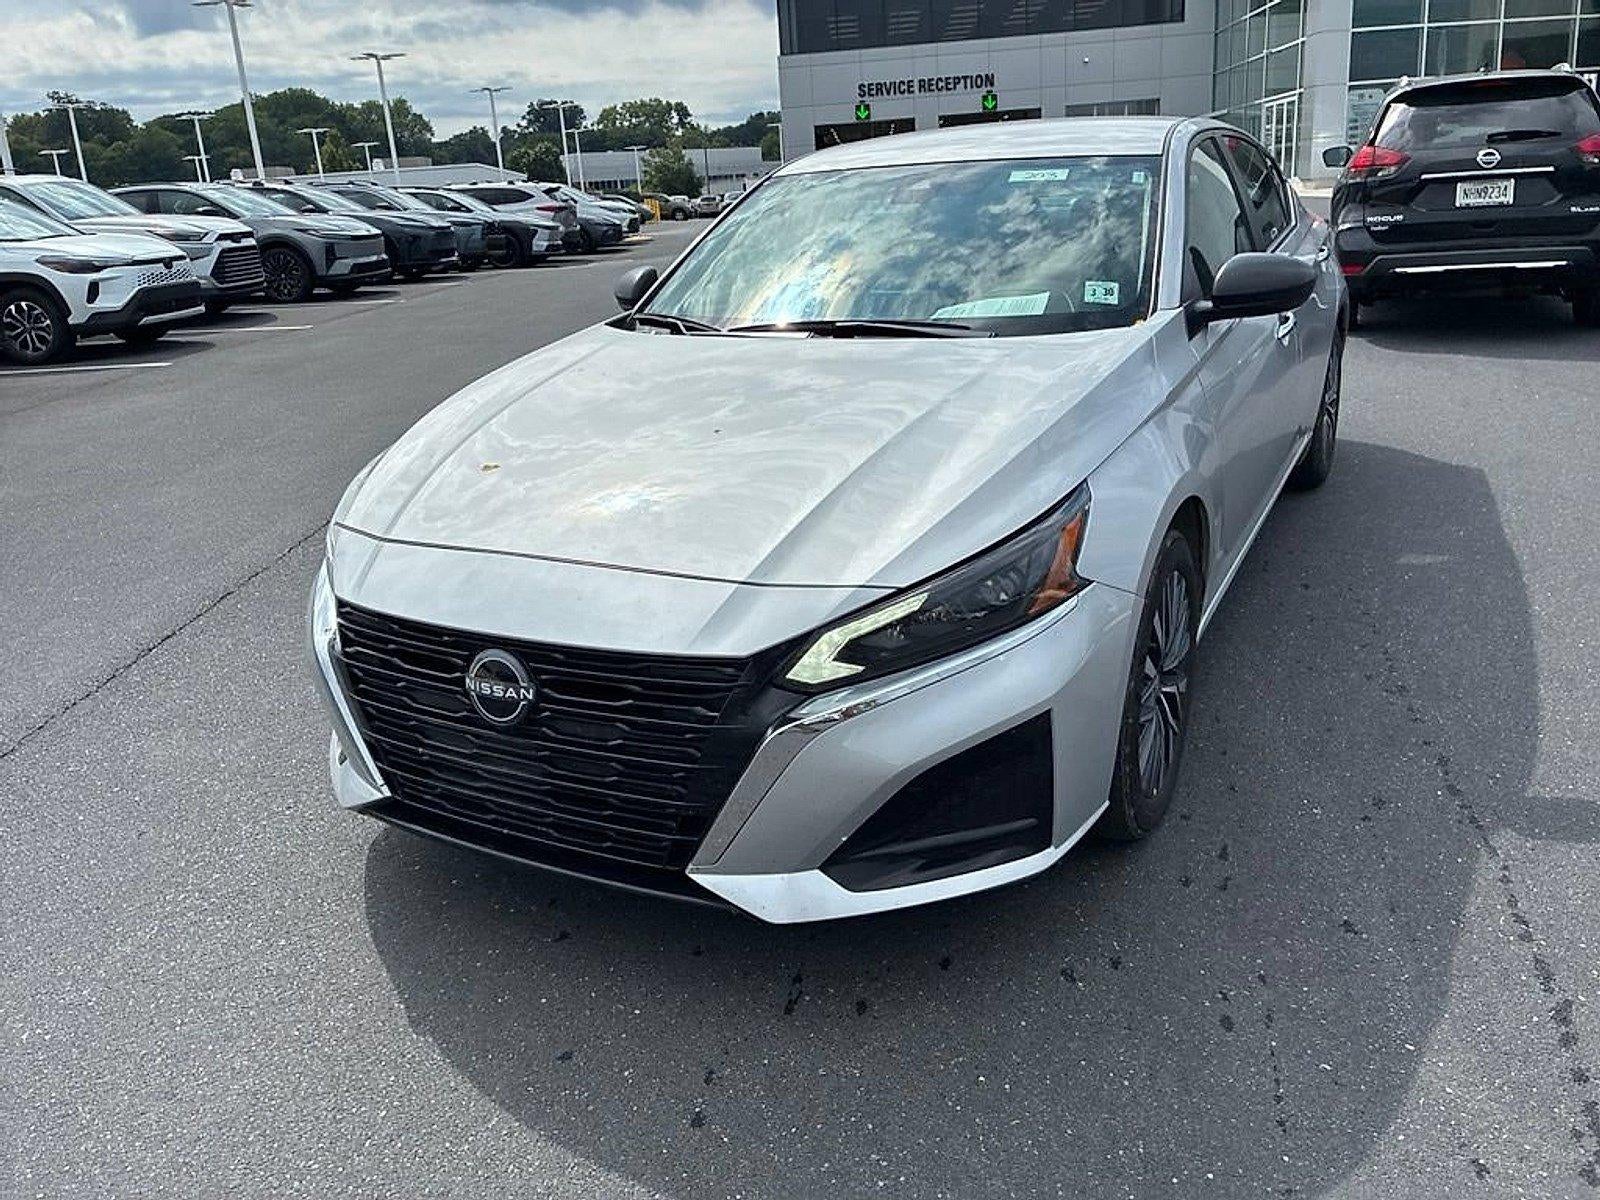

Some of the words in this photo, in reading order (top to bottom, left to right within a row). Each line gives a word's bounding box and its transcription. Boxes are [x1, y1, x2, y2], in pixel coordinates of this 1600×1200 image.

[858, 80, 915, 98] SERVICE
[918, 73, 995, 93] RECEPTION
[465, 676, 534, 700] NISSAN
